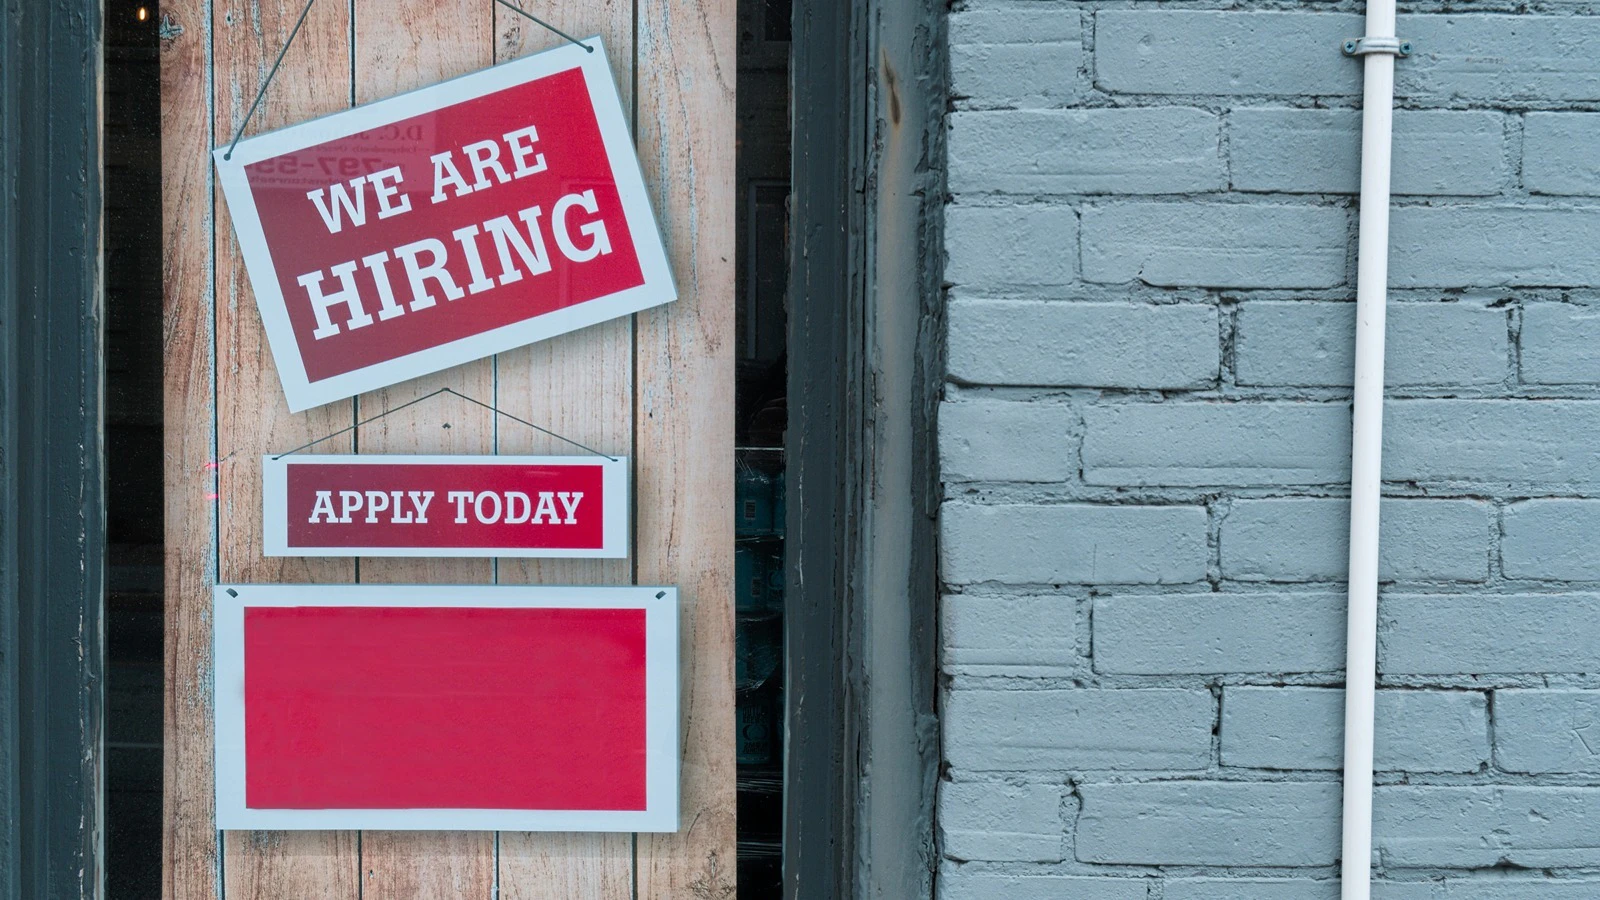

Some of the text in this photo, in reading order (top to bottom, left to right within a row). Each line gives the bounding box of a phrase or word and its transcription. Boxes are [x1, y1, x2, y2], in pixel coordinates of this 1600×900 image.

[306, 124, 548, 234] WE ARE
[296, 188, 613, 341] HIRING
[308, 490, 584, 525] APPLY TODAY
